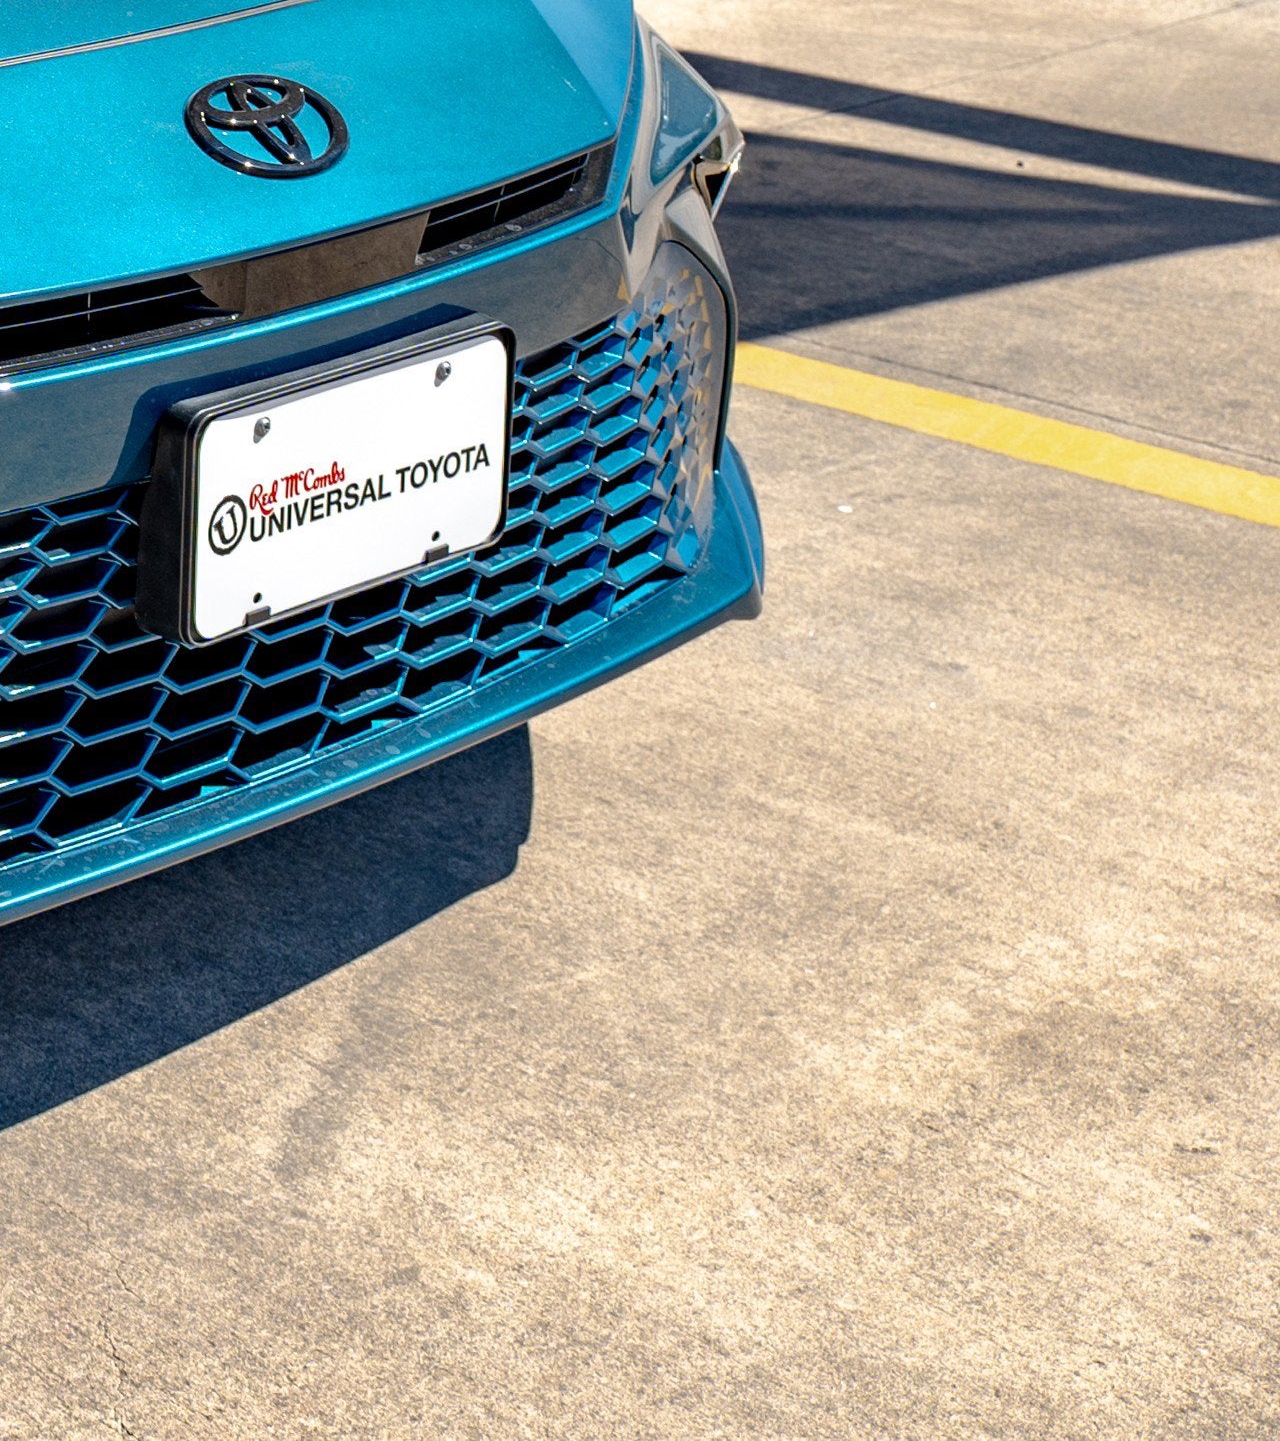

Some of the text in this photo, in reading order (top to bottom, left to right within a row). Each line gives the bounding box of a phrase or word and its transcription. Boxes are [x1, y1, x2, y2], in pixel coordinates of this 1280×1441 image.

[249, 461, 346, 516] Red McCombs
[249, 474, 392, 543] UNIVERSAL
[395, 443, 490, 494] TOYOTA
